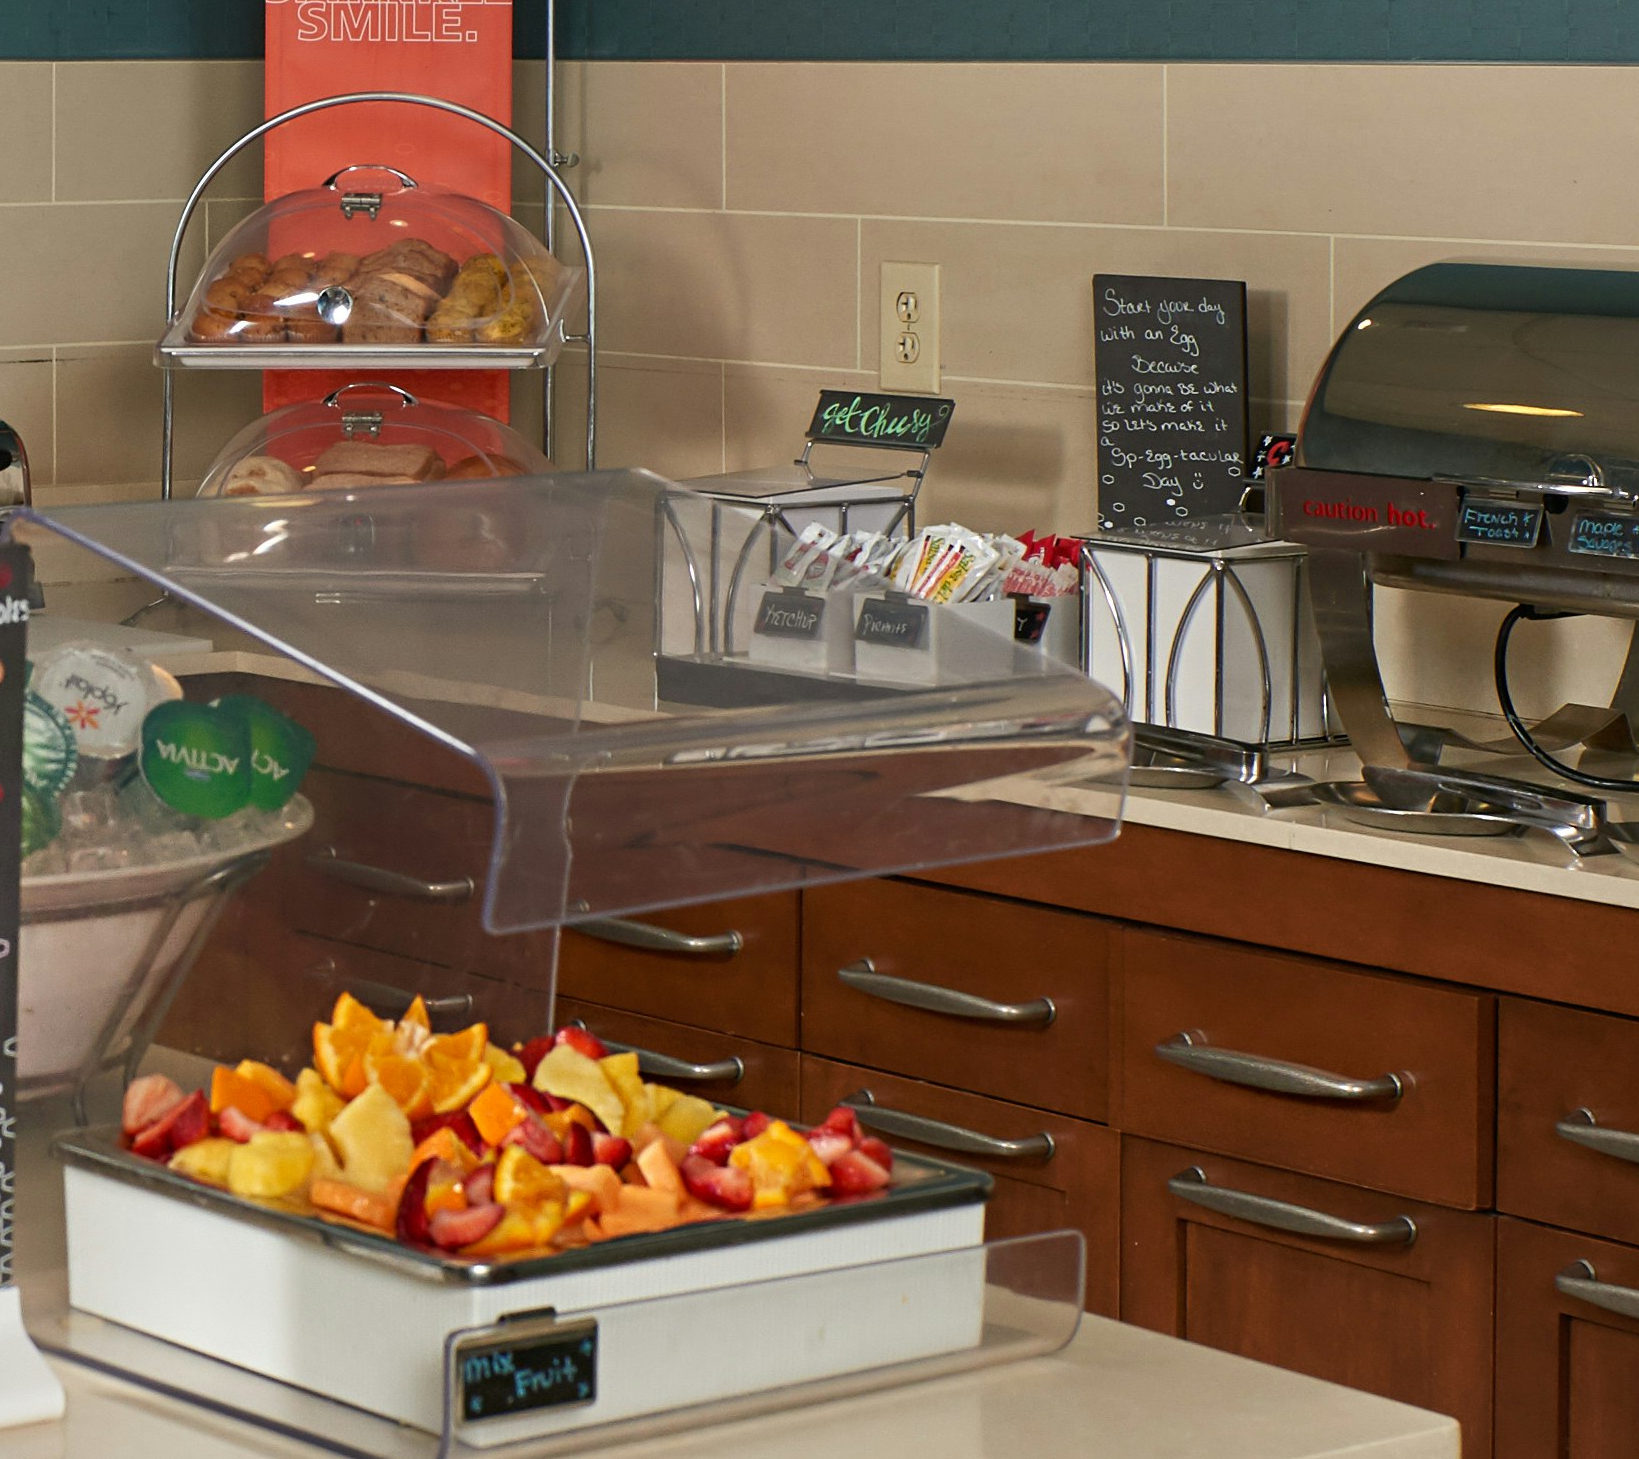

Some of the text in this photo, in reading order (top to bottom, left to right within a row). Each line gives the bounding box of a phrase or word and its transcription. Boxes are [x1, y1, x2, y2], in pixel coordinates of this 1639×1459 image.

[297, 0, 478, 42] SMILE.
[1100, 325, 1135, 342] with
[1144, 330, 1163, 340] an
[1180, 400, 1194, 413] of
[1200, 400, 1215, 413] it
[1214, 419, 1228, 432] it
[1142, 472, 1184, 497] Day
[1303, 497, 1437, 530] caution hot.
[156, 738, 240, 775] ACTIVIA
